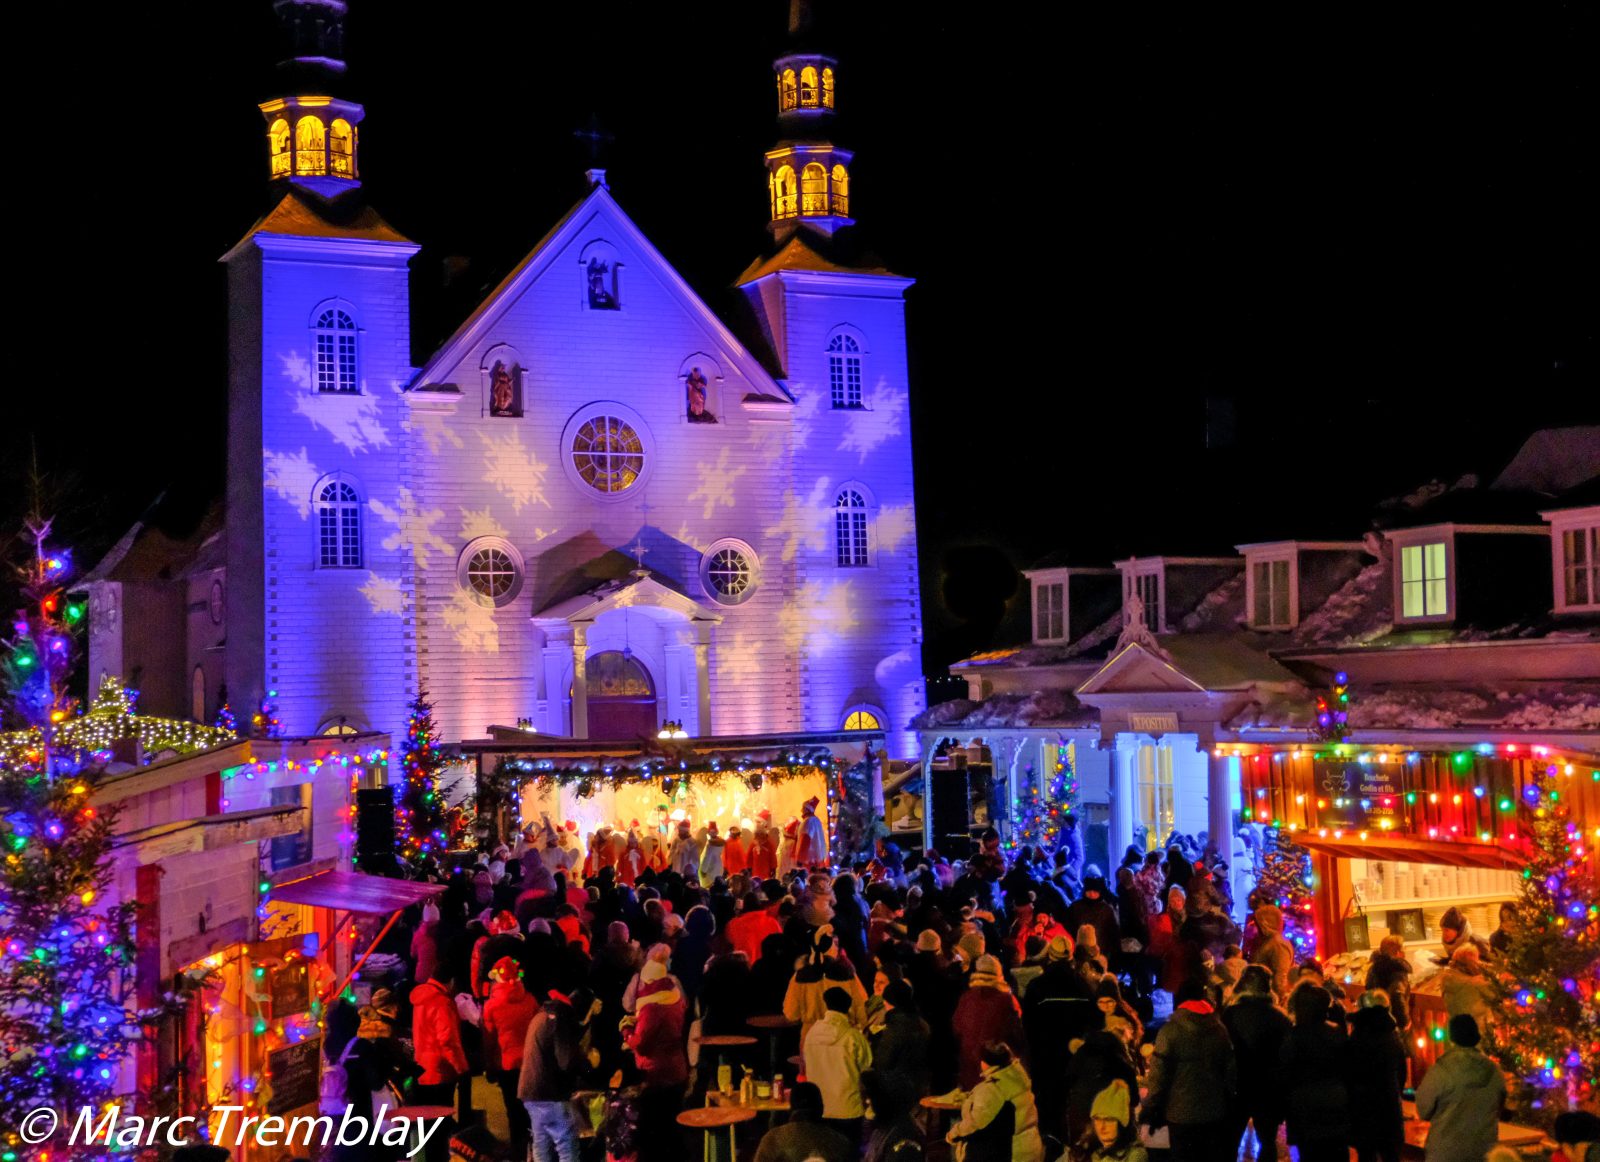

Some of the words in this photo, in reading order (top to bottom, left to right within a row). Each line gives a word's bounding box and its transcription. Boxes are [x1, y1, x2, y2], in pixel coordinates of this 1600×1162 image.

[1132, 716, 1176, 730] EXPOSITION
[1378, 785, 1384, 793] et
[1384, 784, 1395, 793] fils
